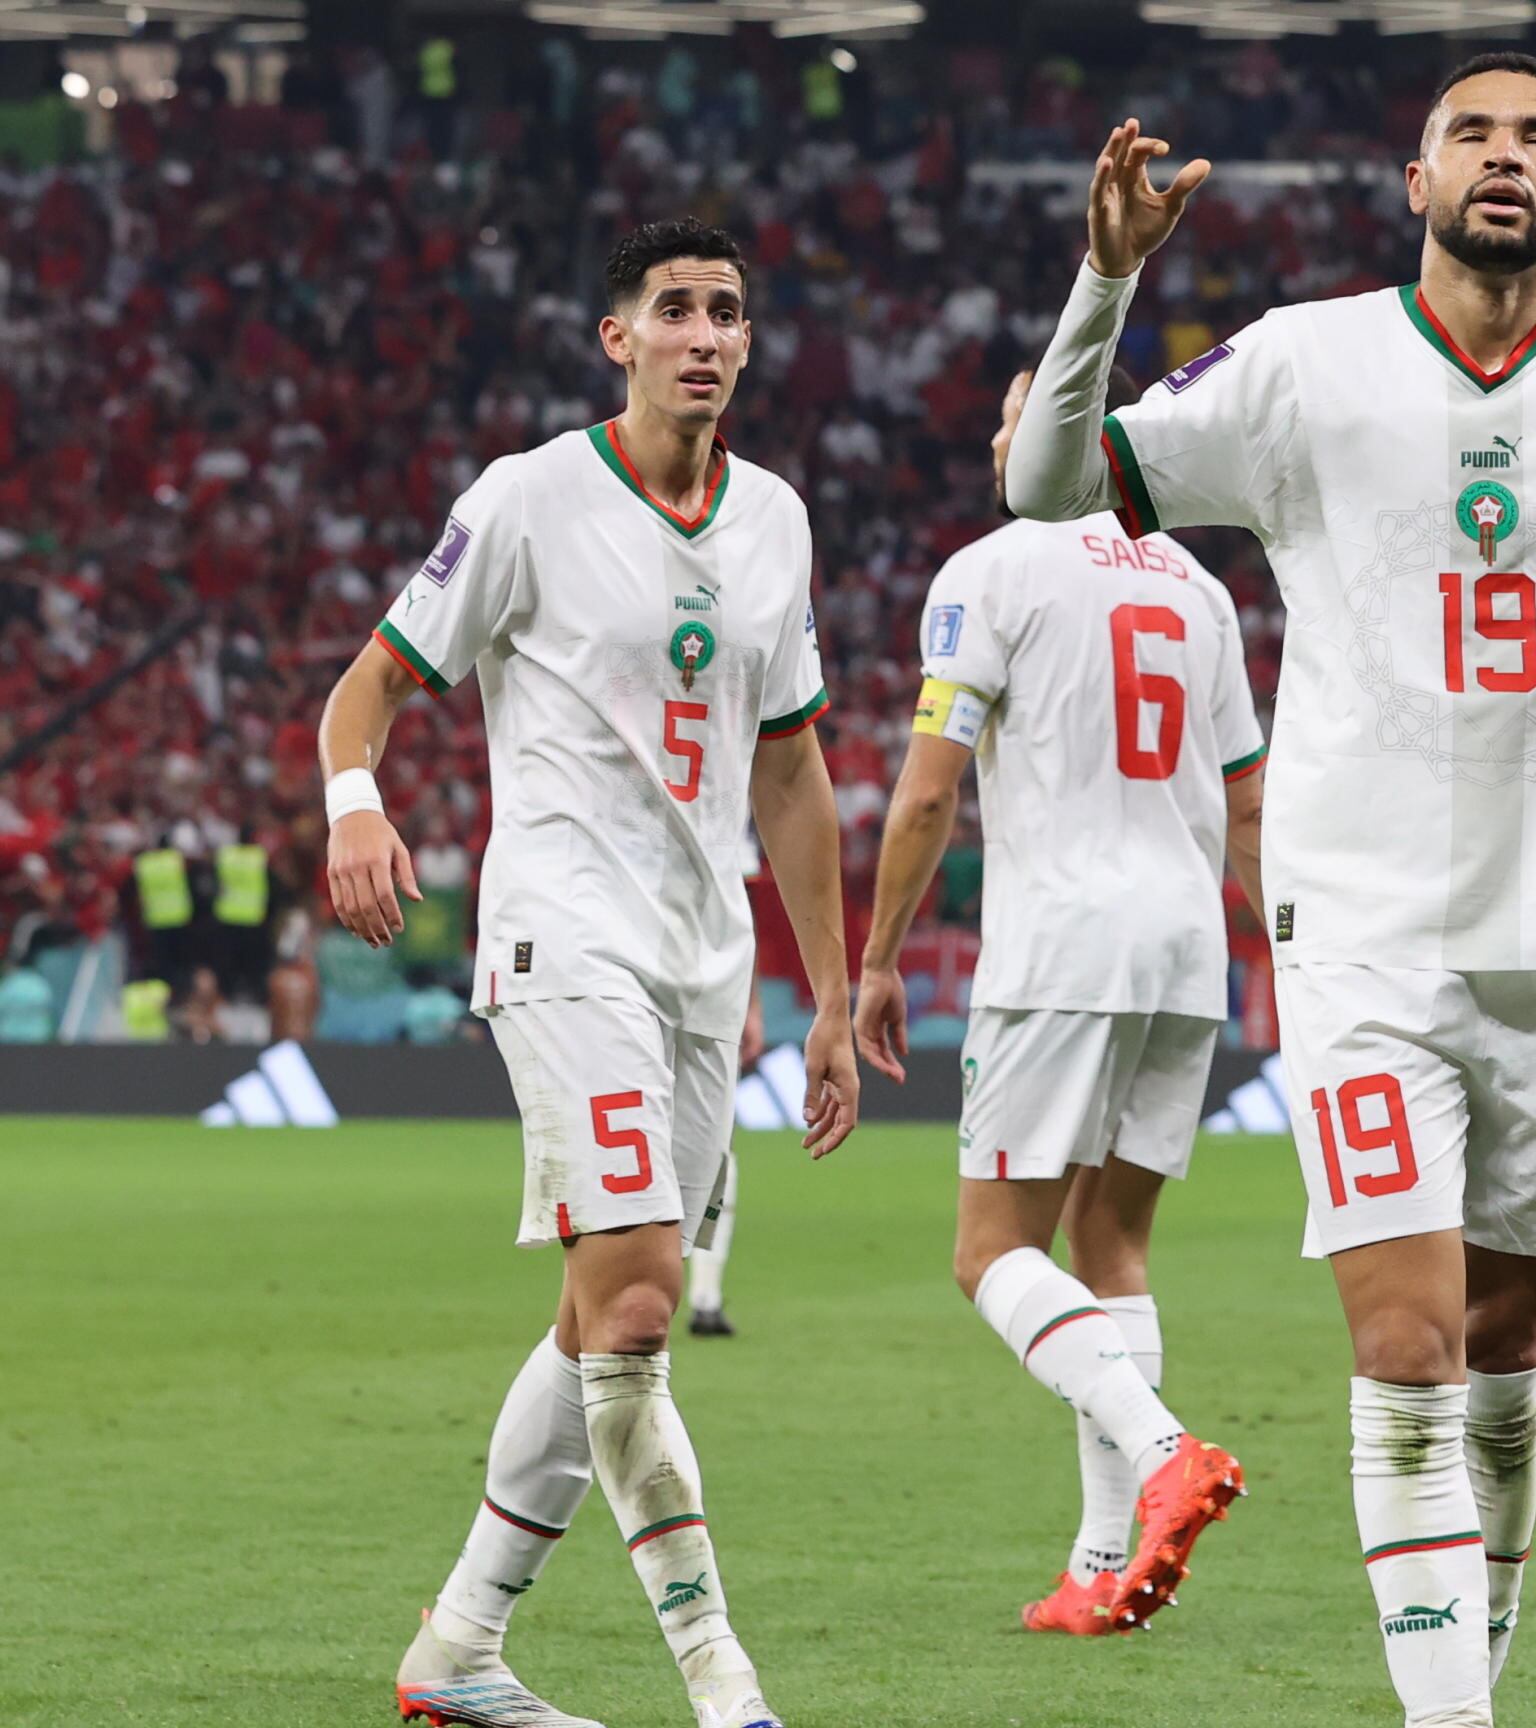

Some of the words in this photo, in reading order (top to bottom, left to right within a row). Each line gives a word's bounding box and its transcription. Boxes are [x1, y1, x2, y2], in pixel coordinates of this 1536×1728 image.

[1461, 451, 1510, 468] PUMA
[1083, 535, 1188, 580] SAISS
[1110, 604, 1185, 780] 6
[664, 700, 708, 802] 5
[591, 1091, 653, 1194] 5
[1311, 1073, 1419, 1208] 19
[657, 1589, 697, 1616] PUMA
[1384, 1616, 1444, 1637] PUMA
